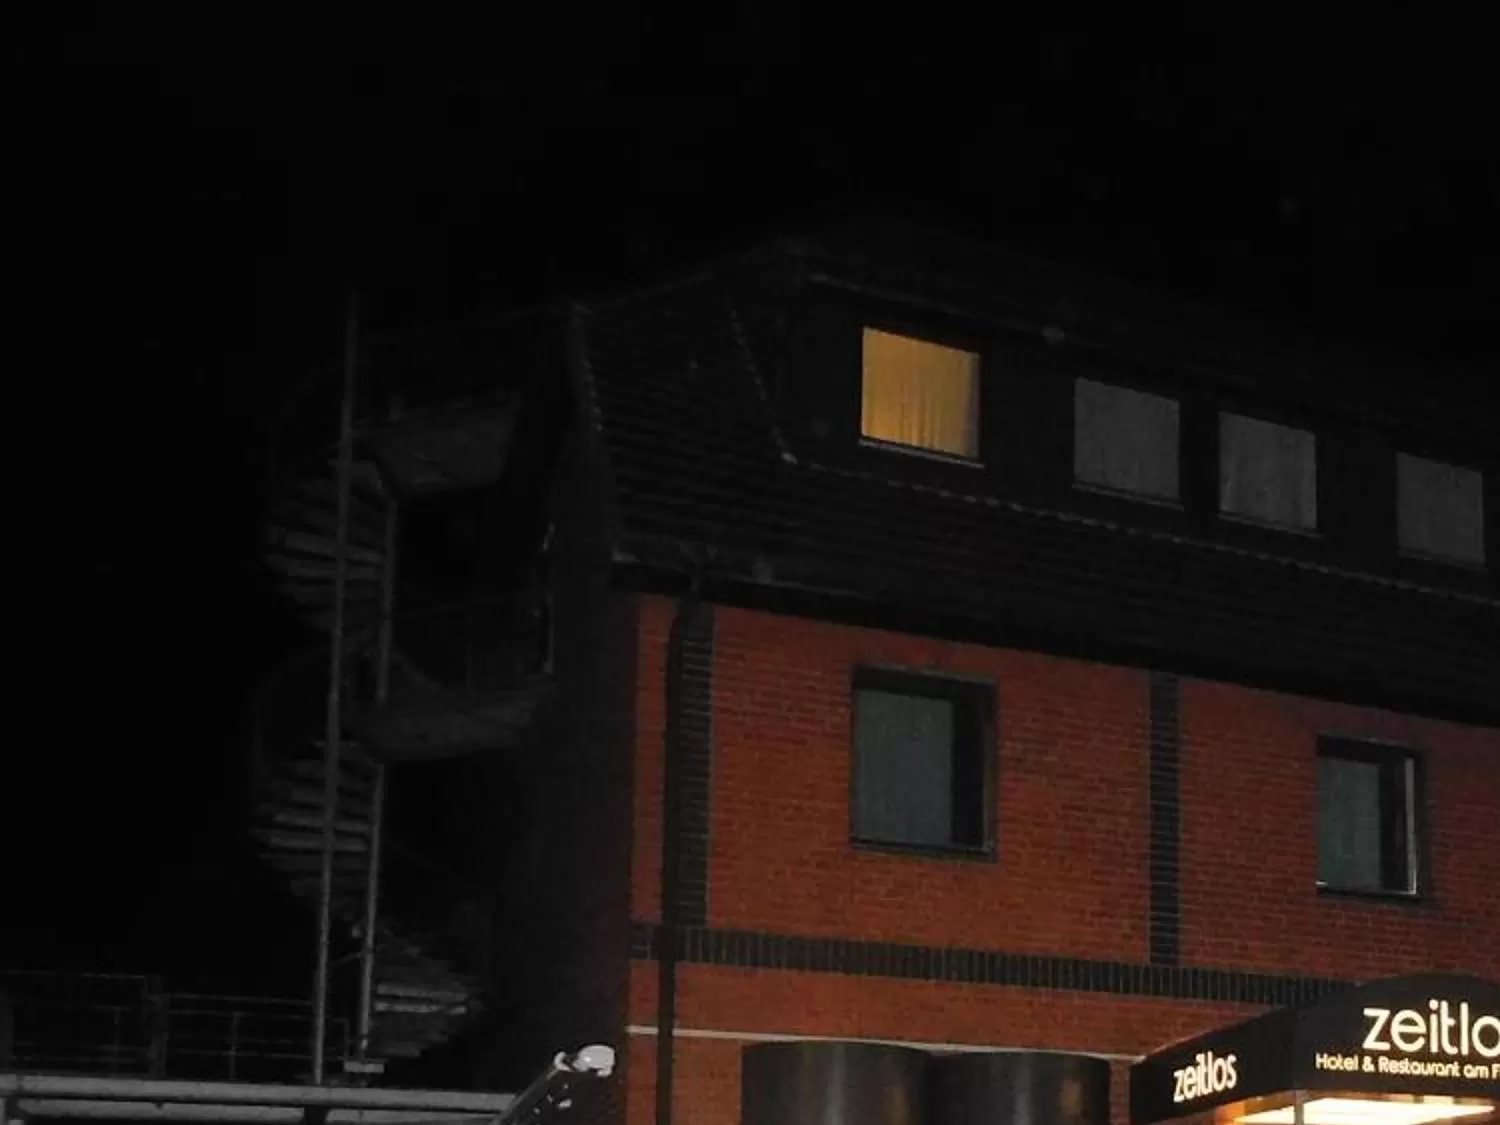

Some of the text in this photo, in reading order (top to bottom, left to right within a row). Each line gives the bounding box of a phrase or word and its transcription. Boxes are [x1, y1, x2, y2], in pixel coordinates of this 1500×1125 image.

[1173, 1051, 1237, 1103] zeitlos
[1315, 1052, 1359, 1072] Hotel
[1362, 1055, 1375, 1073] &
[1378, 1056, 1460, 1077] Restaurant
[1463, 1064, 1489, 1079] am
